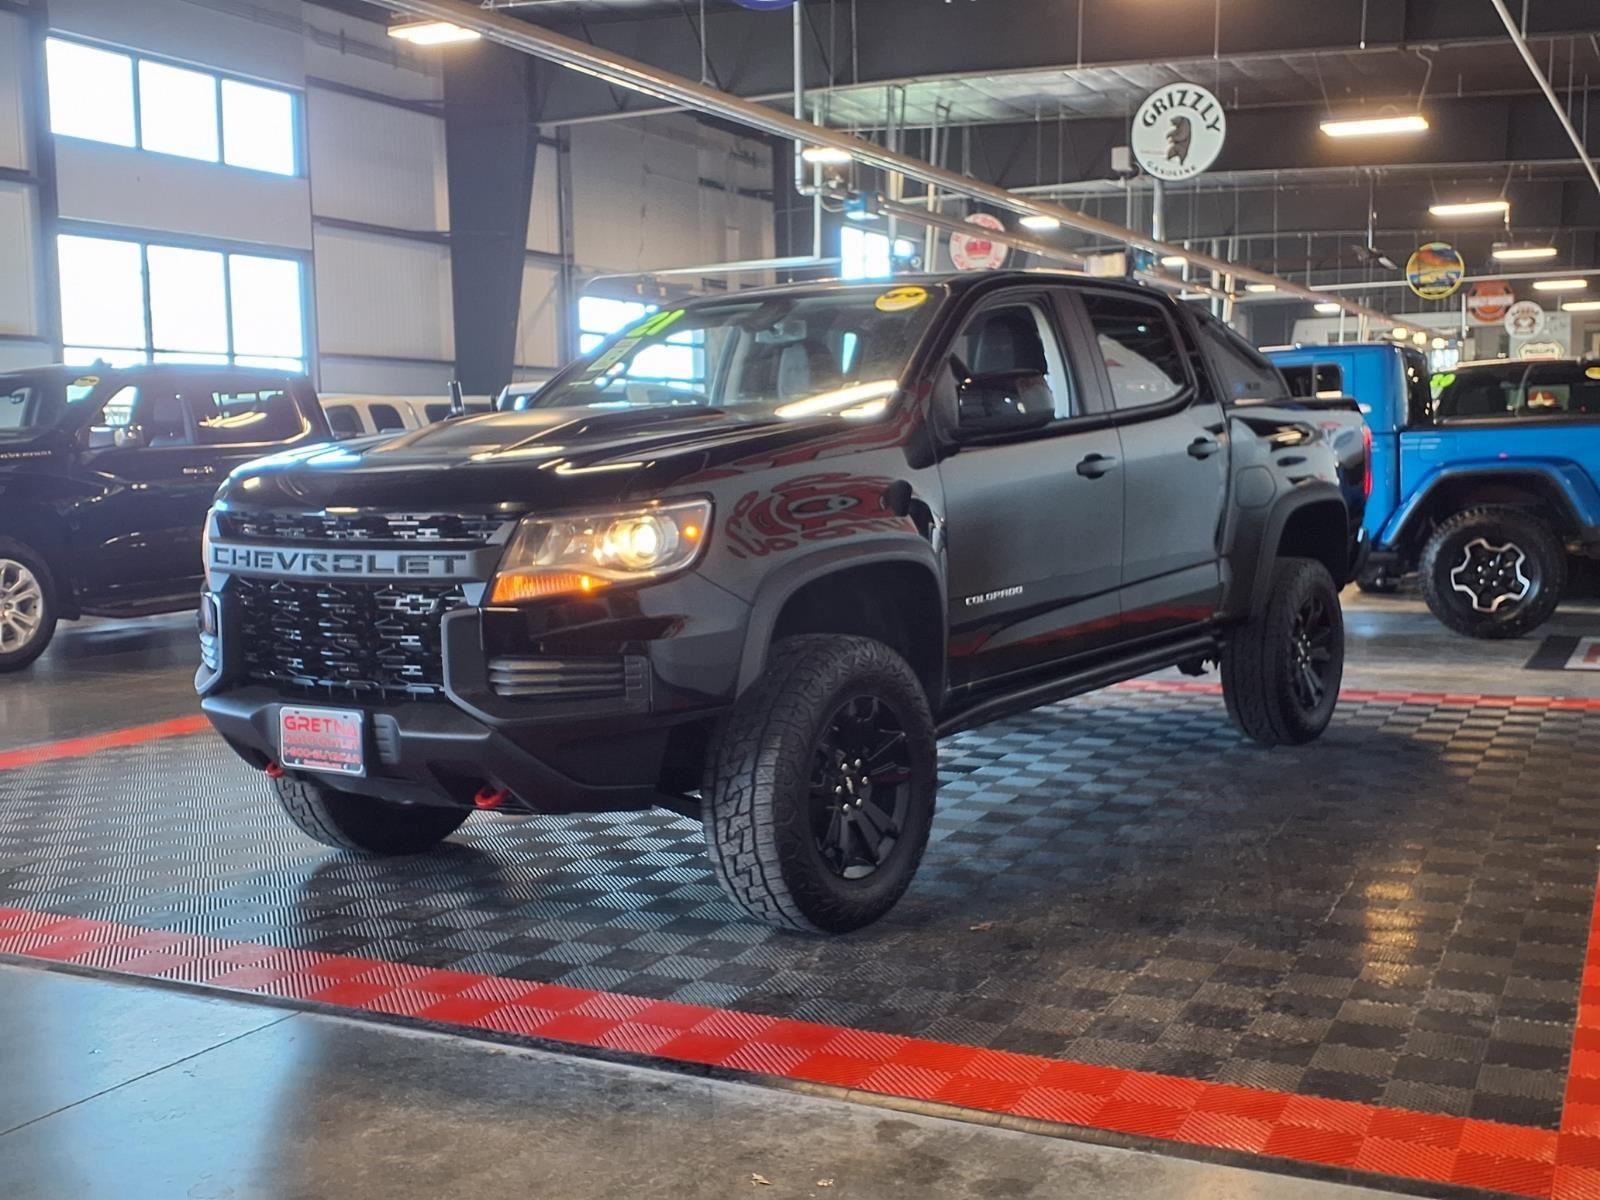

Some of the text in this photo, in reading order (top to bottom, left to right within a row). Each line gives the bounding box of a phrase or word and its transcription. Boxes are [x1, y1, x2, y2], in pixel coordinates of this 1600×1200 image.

[1142, 88, 1221, 132] GRIZZLY
[213, 546, 467, 574] CHEVROLET
[965, 585, 1023, 606] COLORADO
[283, 715, 360, 738] GRETNA
